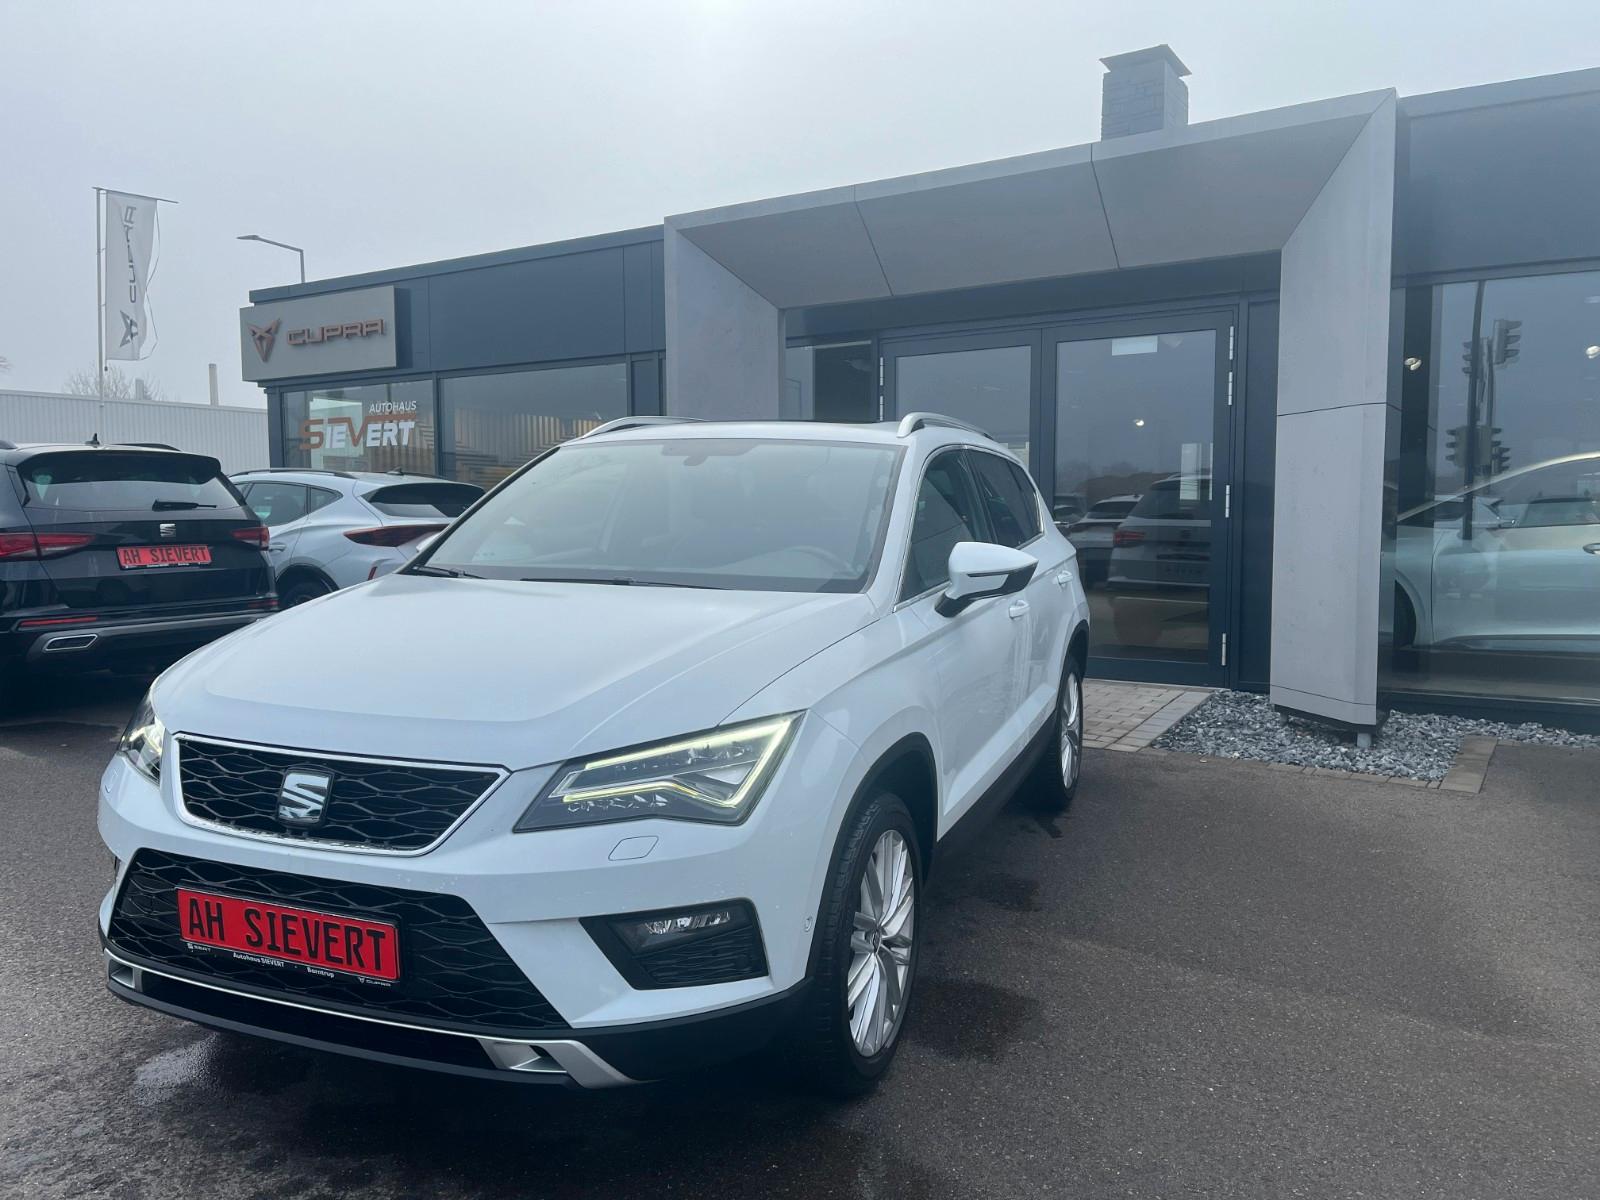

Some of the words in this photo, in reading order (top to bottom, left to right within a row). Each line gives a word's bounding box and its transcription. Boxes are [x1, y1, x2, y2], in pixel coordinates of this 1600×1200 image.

[123, 205, 138, 304] CUA
[287, 318, 385, 346] CUPRA
[369, 400, 417, 415] AUTOHAUS
[300, 413, 417, 450] SIEVERT
[123, 548, 142, 564] AH
[150, 546, 208, 562] SIEVERT
[188, 896, 226, 942] AH
[244, 907, 386, 972] SIEVERT
[233, 951, 261, 963] Autohaus
[261, 957, 285, 968] SIEVERT
